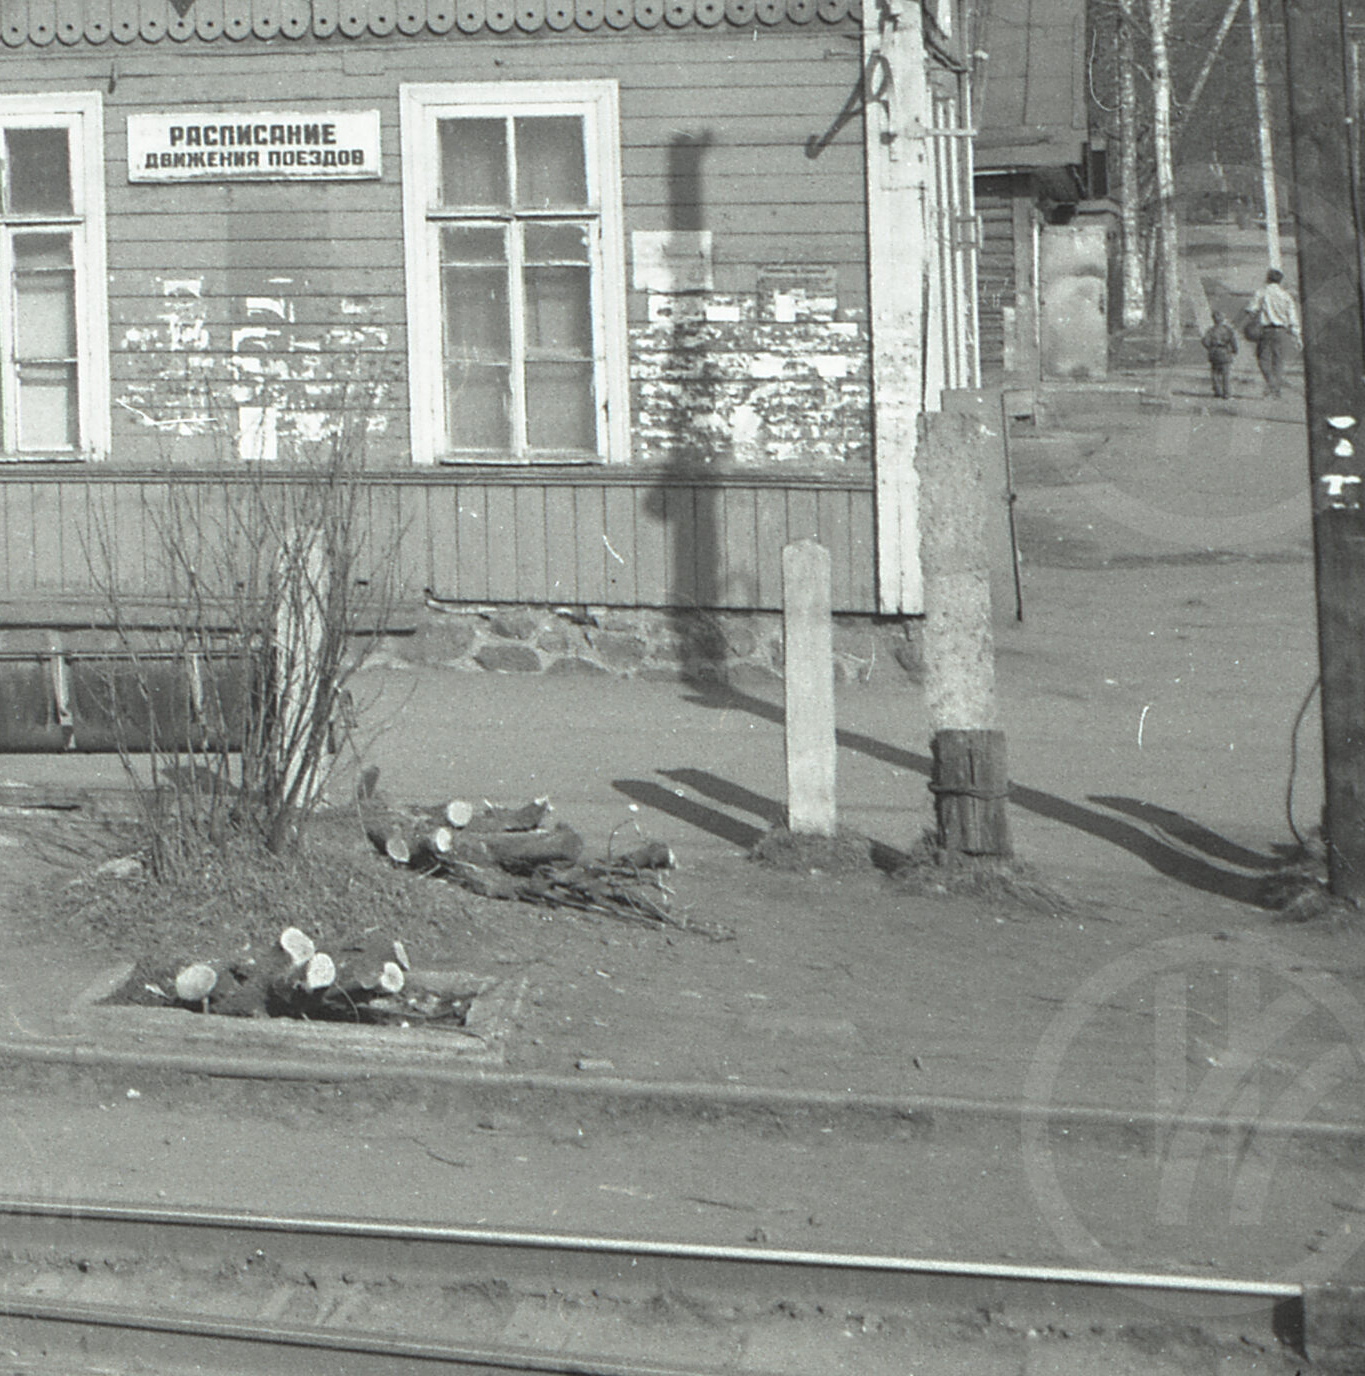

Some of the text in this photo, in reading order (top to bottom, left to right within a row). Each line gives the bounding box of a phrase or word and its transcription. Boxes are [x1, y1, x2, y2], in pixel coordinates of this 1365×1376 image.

[169, 123, 337, 147] РАСПИСАНИЕ
[144, 149, 365, 170] ДВИЖЕНИЯ ПОЕЗДОВ
